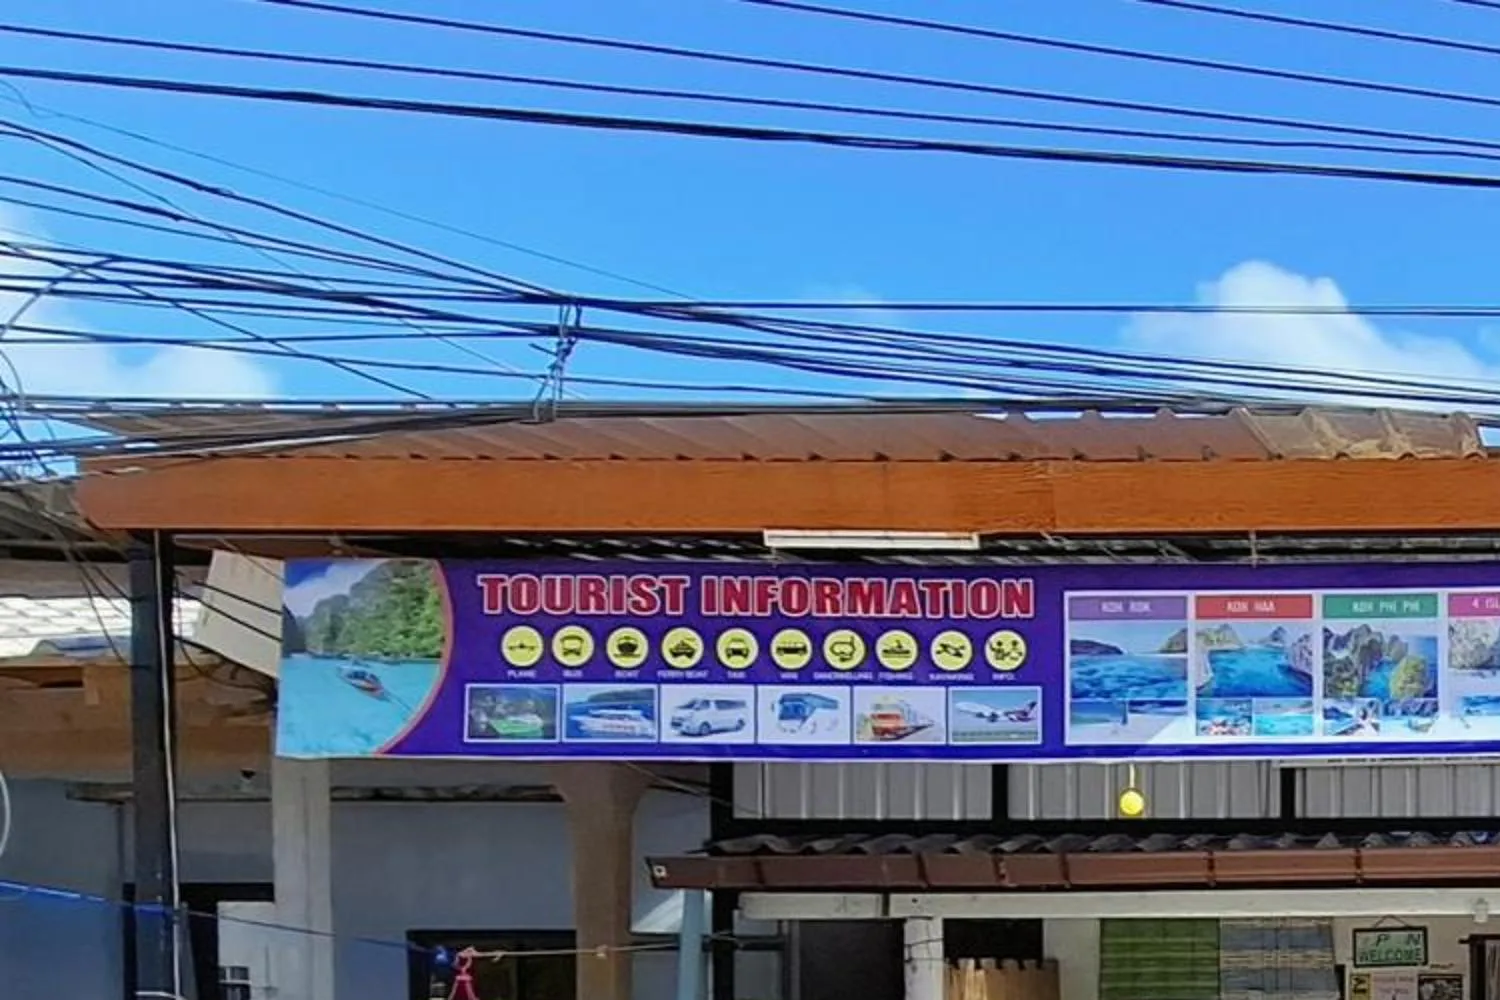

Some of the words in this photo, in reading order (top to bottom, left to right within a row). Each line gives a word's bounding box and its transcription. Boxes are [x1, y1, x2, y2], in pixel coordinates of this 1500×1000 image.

[478, 573, 690, 615] TOURIST
[701, 575, 1036, 619] INFORMATION
[1359, 949, 1421, 962] WELCOME
